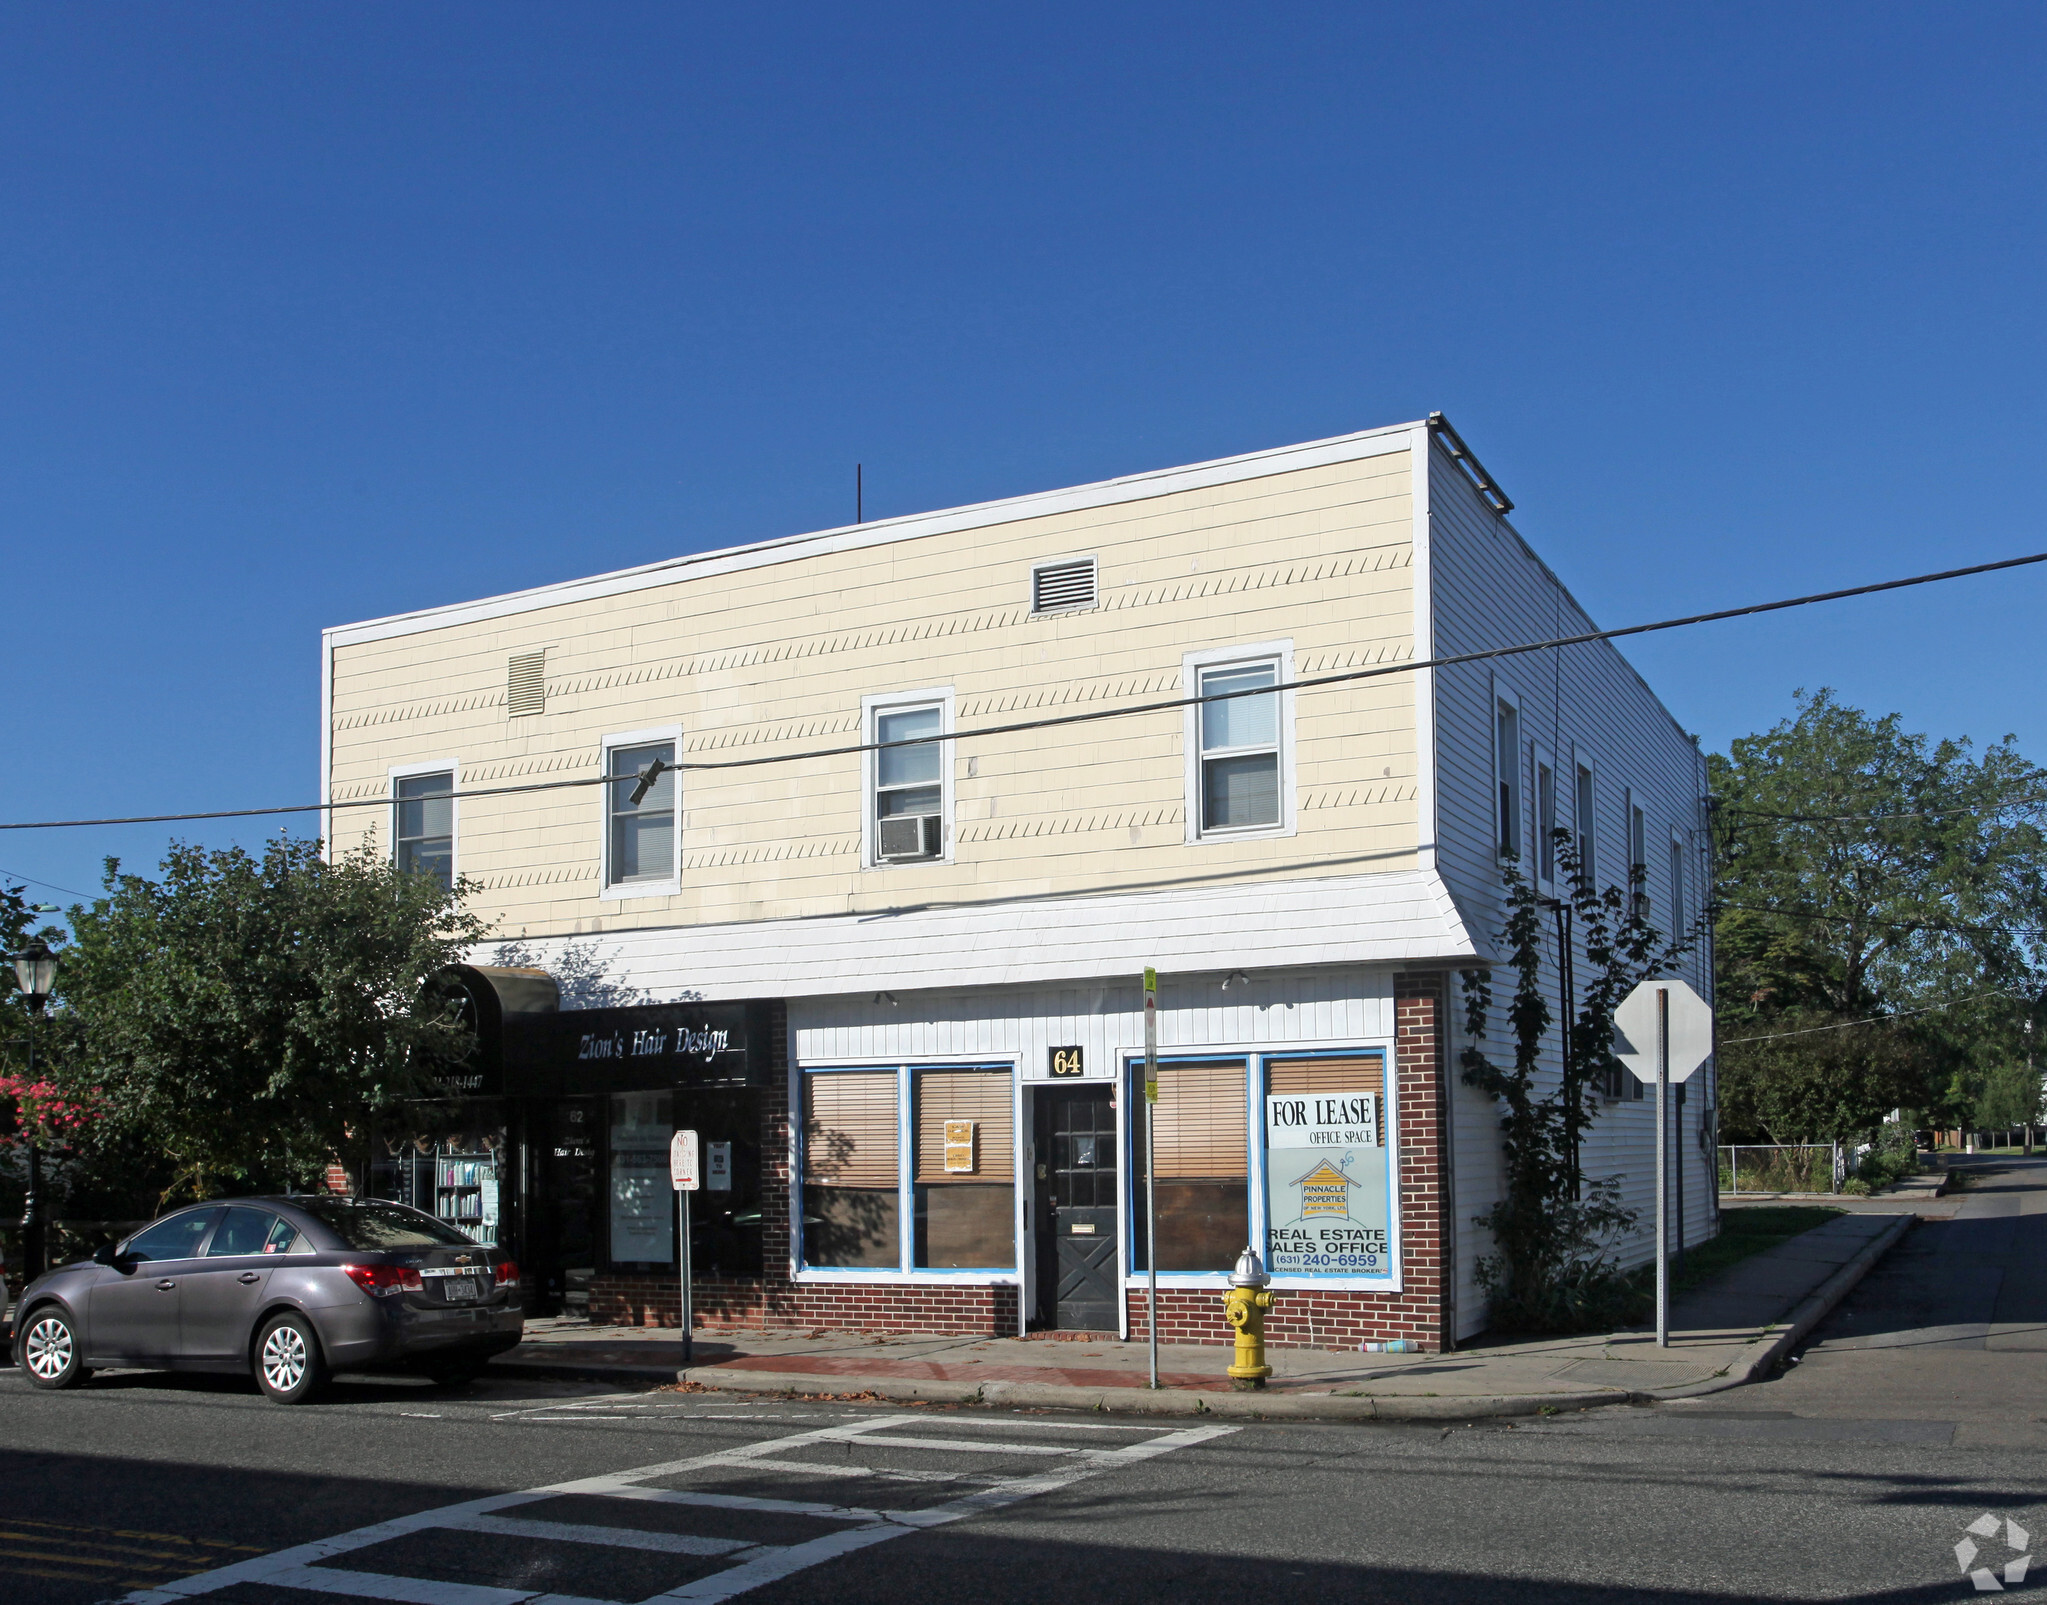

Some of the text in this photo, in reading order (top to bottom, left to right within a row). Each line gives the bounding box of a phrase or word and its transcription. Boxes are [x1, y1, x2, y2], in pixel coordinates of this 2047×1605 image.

[578, 1023, 729, 1063] Zion's Hair Design
[1054, 1050, 1081, 1074] 64
[570, 1110, 584, 1123] 62
[1272, 1098, 1372, 1127] FOR LEASE
[677, 1136, 688, 1147] NO
[1309, 1130, 1373, 1145] OFFICE SPACE
[1303, 1185, 1346, 1193] PINNACLE
[1303, 1195, 1346, 1203] PROPERTIES
[1267, 1229, 1385, 1241] REAL ESTATE
[1266, 1242, 1388, 1254] SALES OFFICE
[1276, 1254, 1377, 1267] (631) 240-6959
